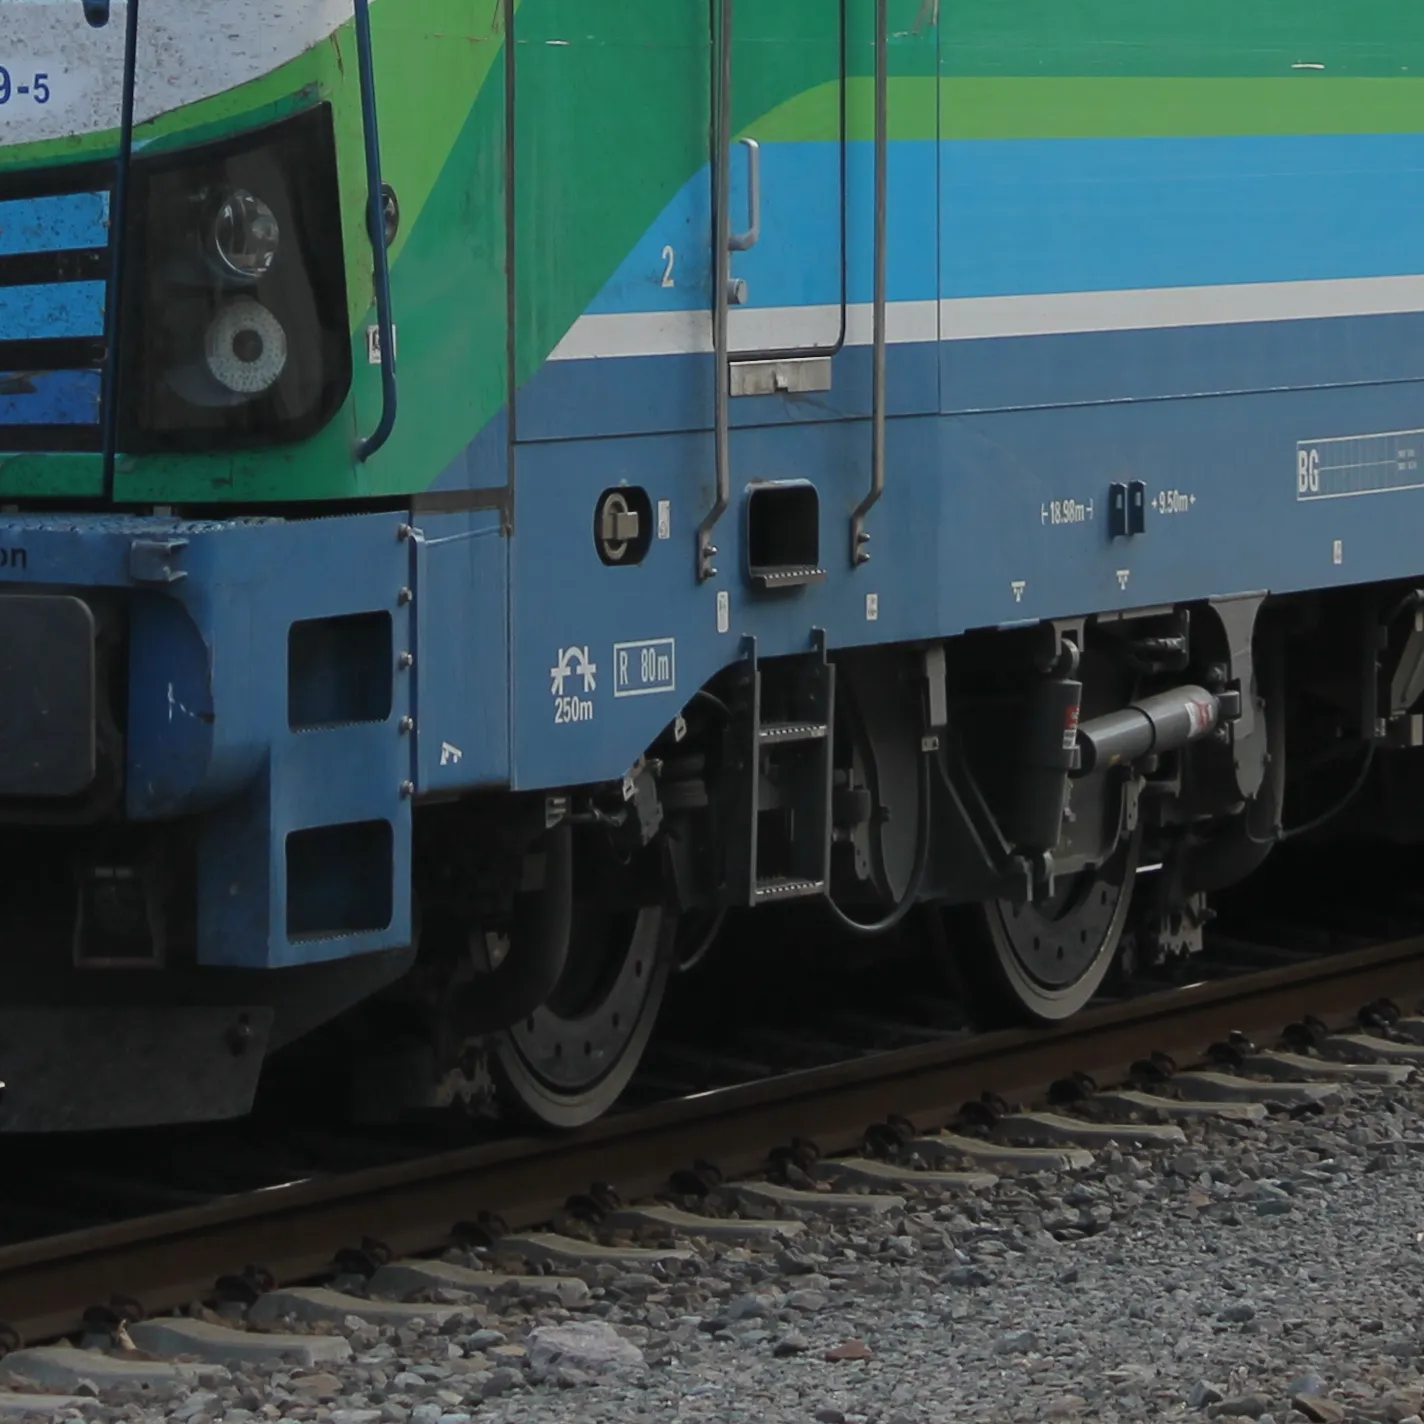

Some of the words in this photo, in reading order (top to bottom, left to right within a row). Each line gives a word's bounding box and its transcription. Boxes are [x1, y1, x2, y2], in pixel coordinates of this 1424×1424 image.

[660, 245, 675, 288] 2
[1298, 448, 1320, 492] BG
[619, 650, 629, 685] R
[554, 695, 594, 724] 250m
